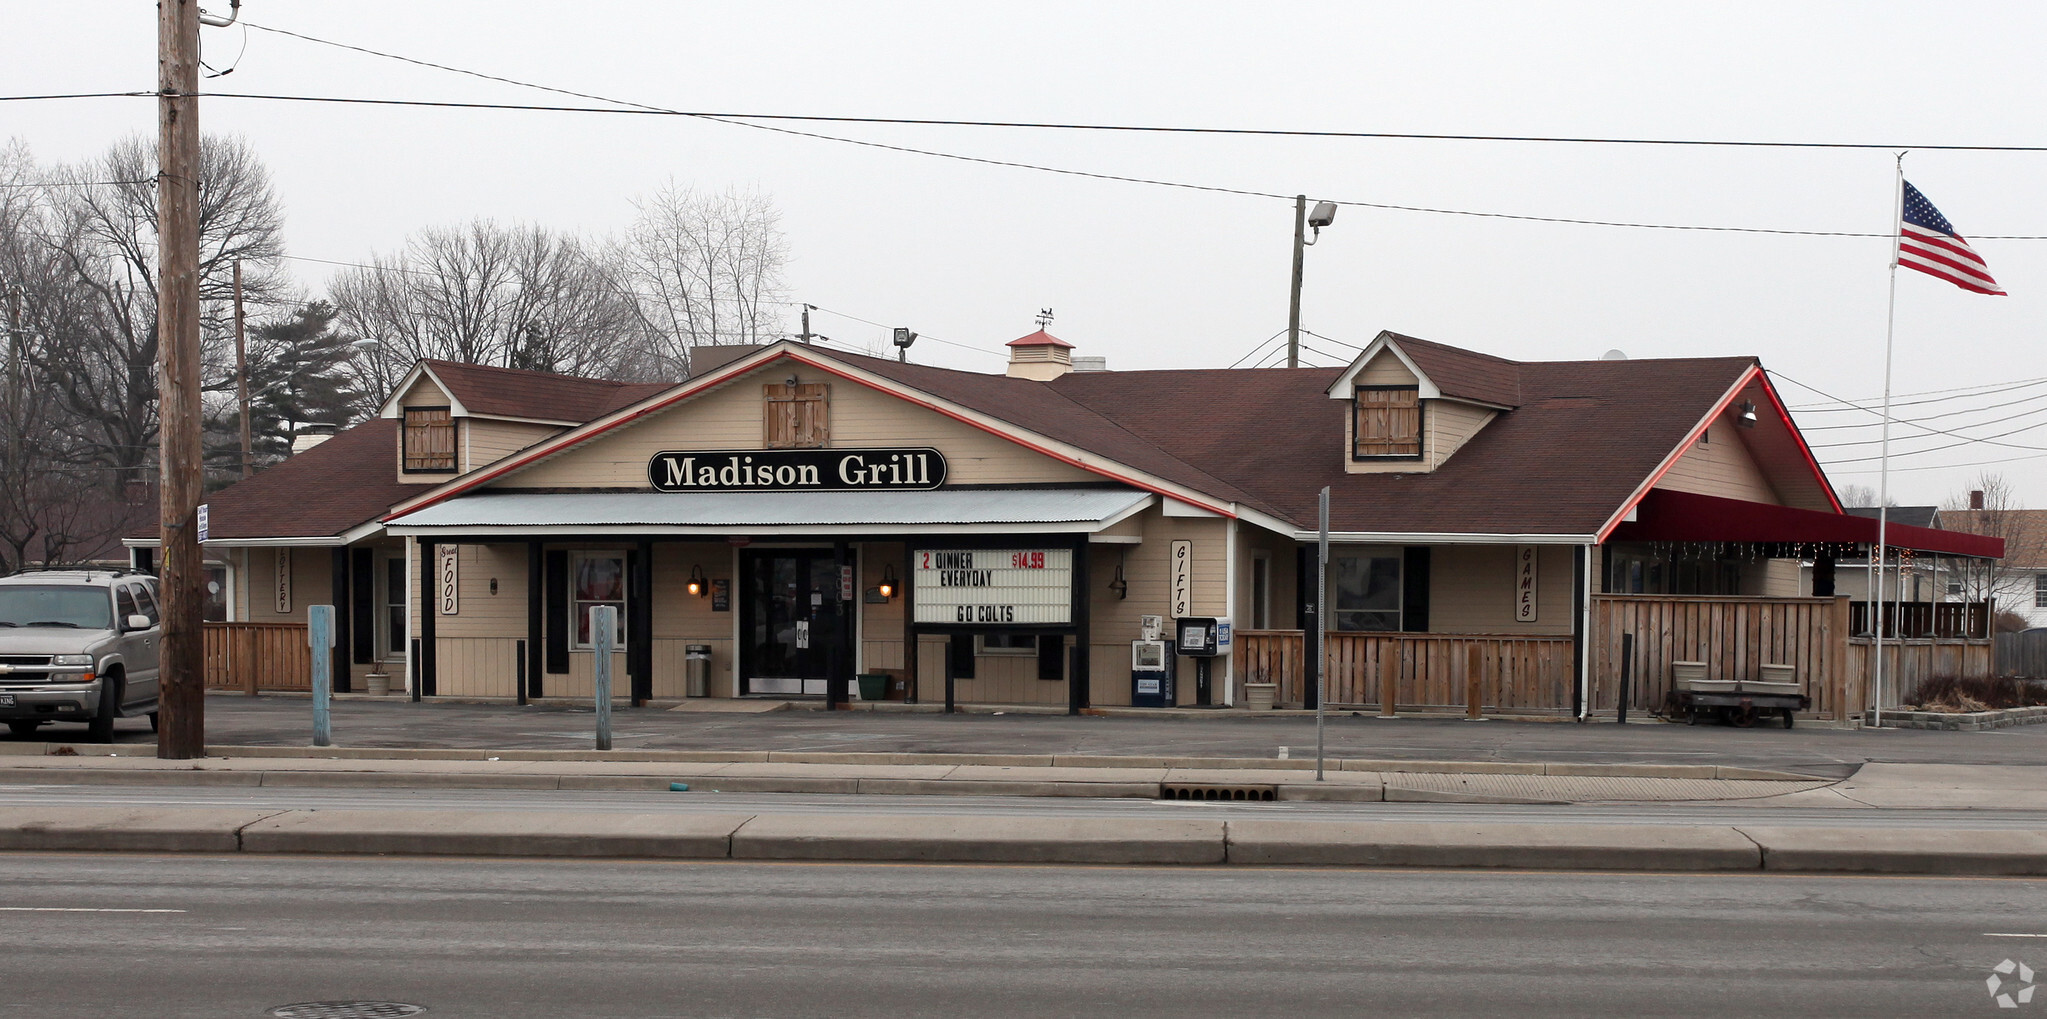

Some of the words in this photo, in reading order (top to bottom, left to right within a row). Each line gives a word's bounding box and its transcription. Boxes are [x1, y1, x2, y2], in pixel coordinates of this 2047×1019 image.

[663, 456, 821, 486] Madison
[838, 454, 930, 485] Grill
[279, 547, 287, 611] LOTTERY
[923, 552, 930, 569] 2
[935, 552, 973, 569] DINNER
[1012, 552, 1044, 569] $14.99
[940, 570, 992, 587] EVERYDAY
[1176, 545, 1186, 614] GIFTS
[444, 557, 454, 612] FOOD
[1520, 548, 1532, 617] GAMES
[957, 605, 973, 622] GO
[978, 605, 1013, 622] COLTS
